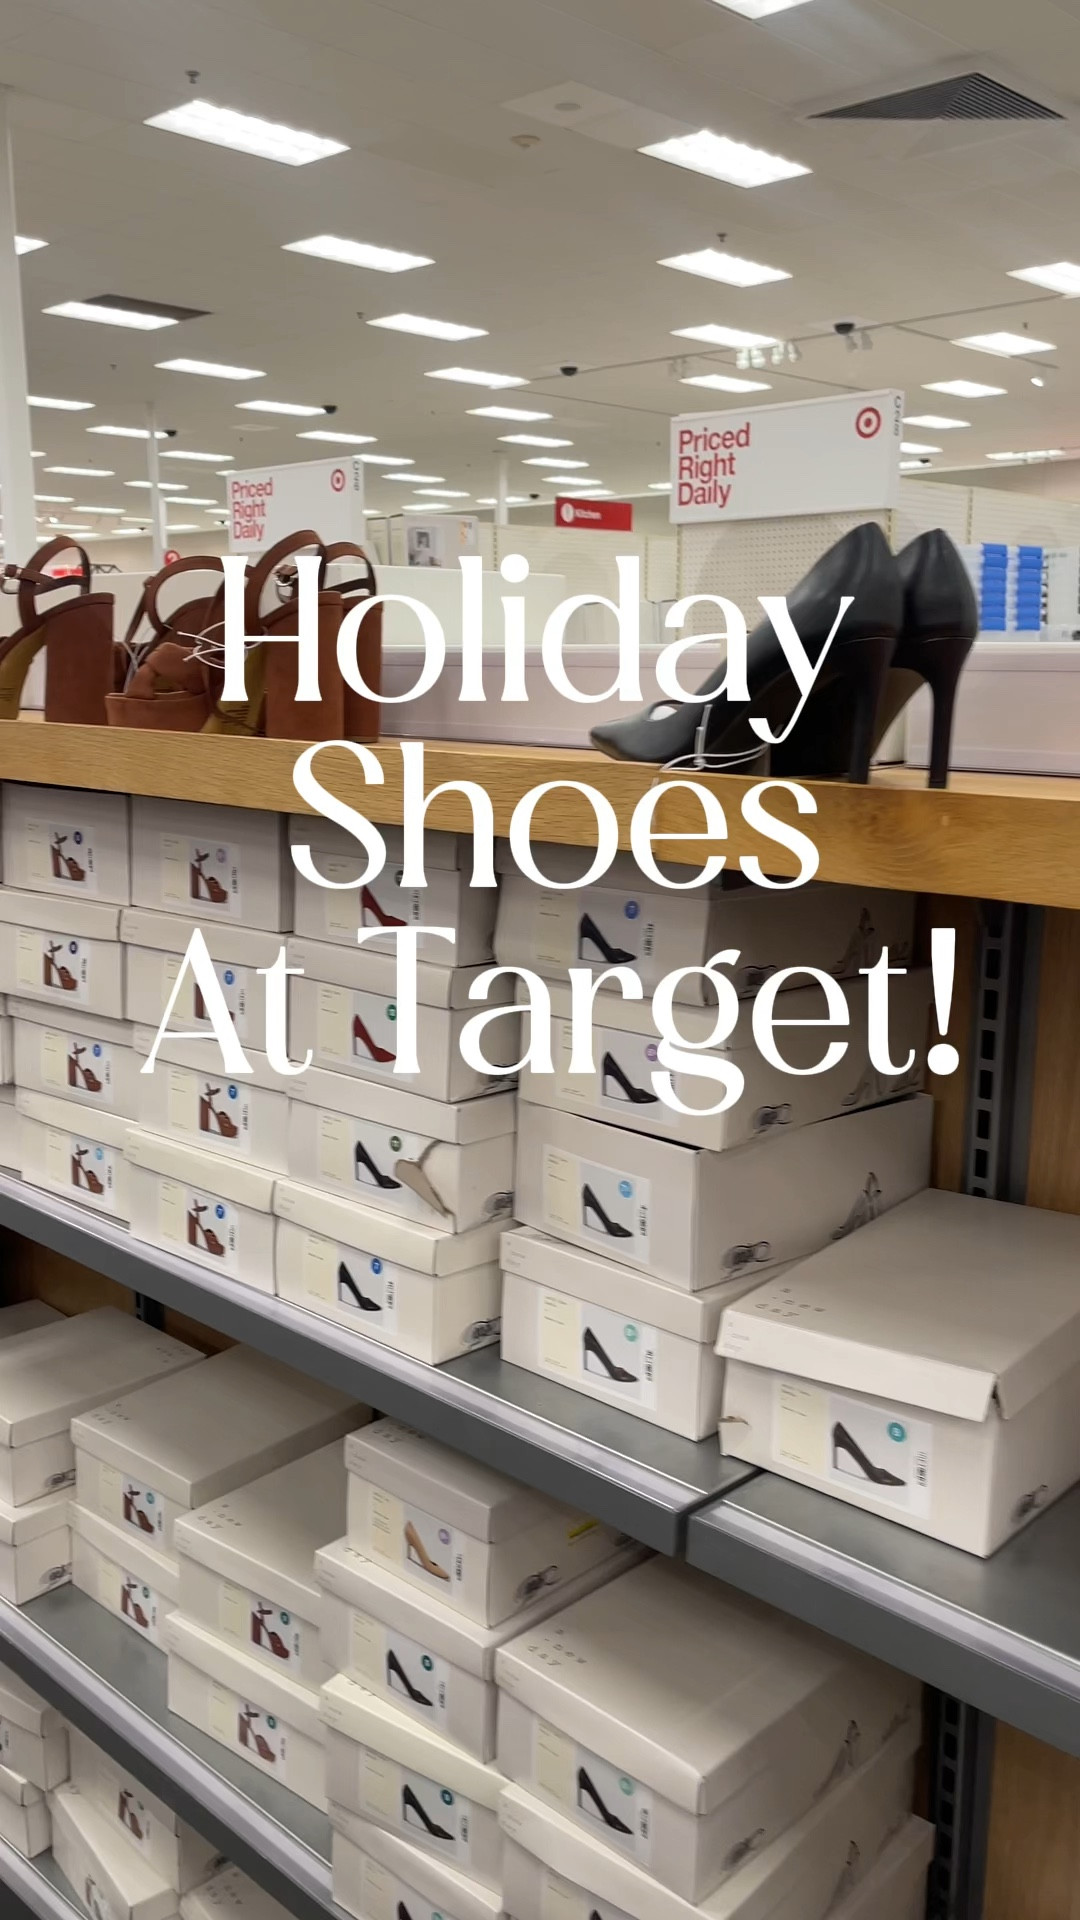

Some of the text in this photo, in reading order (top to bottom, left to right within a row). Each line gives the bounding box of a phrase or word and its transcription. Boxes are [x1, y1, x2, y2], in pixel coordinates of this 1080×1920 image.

[678, 421, 751, 454] Priced
[678, 452, 736, 484] Right
[231, 477, 273, 499] Priced
[677, 479, 732, 509] Daily
[232, 499, 267, 523] Right
[233, 519, 265, 542] Daily
